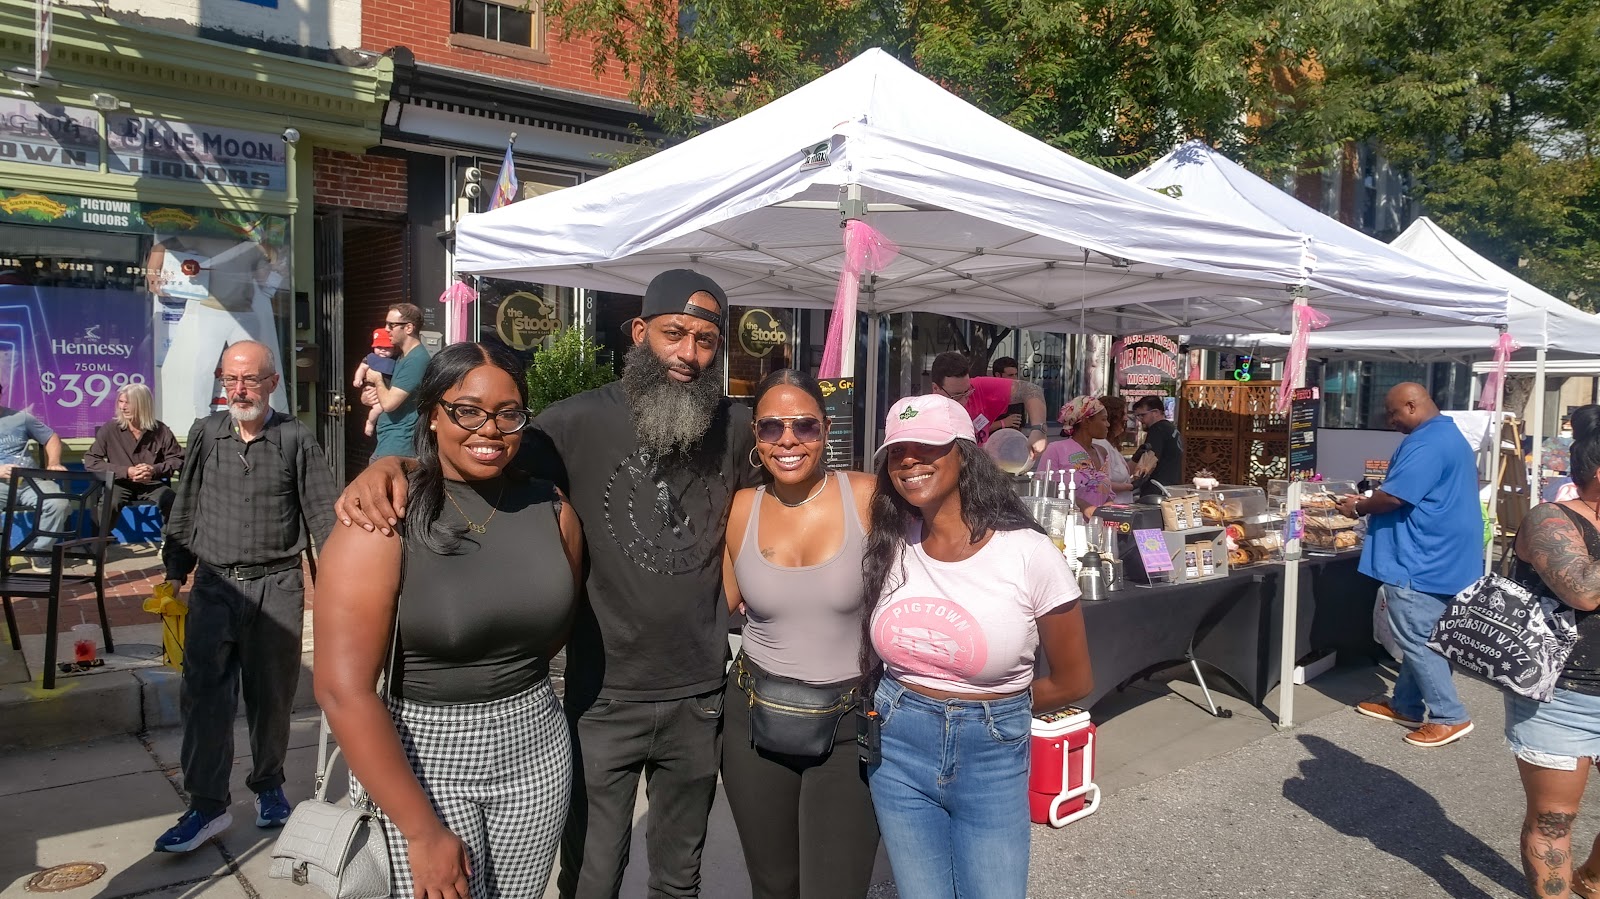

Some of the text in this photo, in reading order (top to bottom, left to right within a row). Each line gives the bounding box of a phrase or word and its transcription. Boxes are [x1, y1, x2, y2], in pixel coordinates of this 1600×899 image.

[121, 118, 195, 152] BLUE
[202, 132, 273, 161] MOON
[128, 157, 270, 186] LIQUORS
[80, 197, 131, 213] PIGTOWN
[82, 212, 129, 226] LIQUORS
[0, 258, 21, 267] ER
[57, 262, 94, 271] WINE
[506, 307, 523, 318] the
[514, 315, 562, 332] stoop
[746, 321, 759, 330] the
[751, 328, 787, 345] stoop
[52, 339, 134, 359] Hennessy
[1144, 335, 1178, 356] AFRICAN
[75, 363, 114, 372] 750ML
[1135, 346, 1177, 380] BRAIDING
[1126, 373, 1162, 386] MICHOU
[891, 602, 971, 632] PIGTOWN
